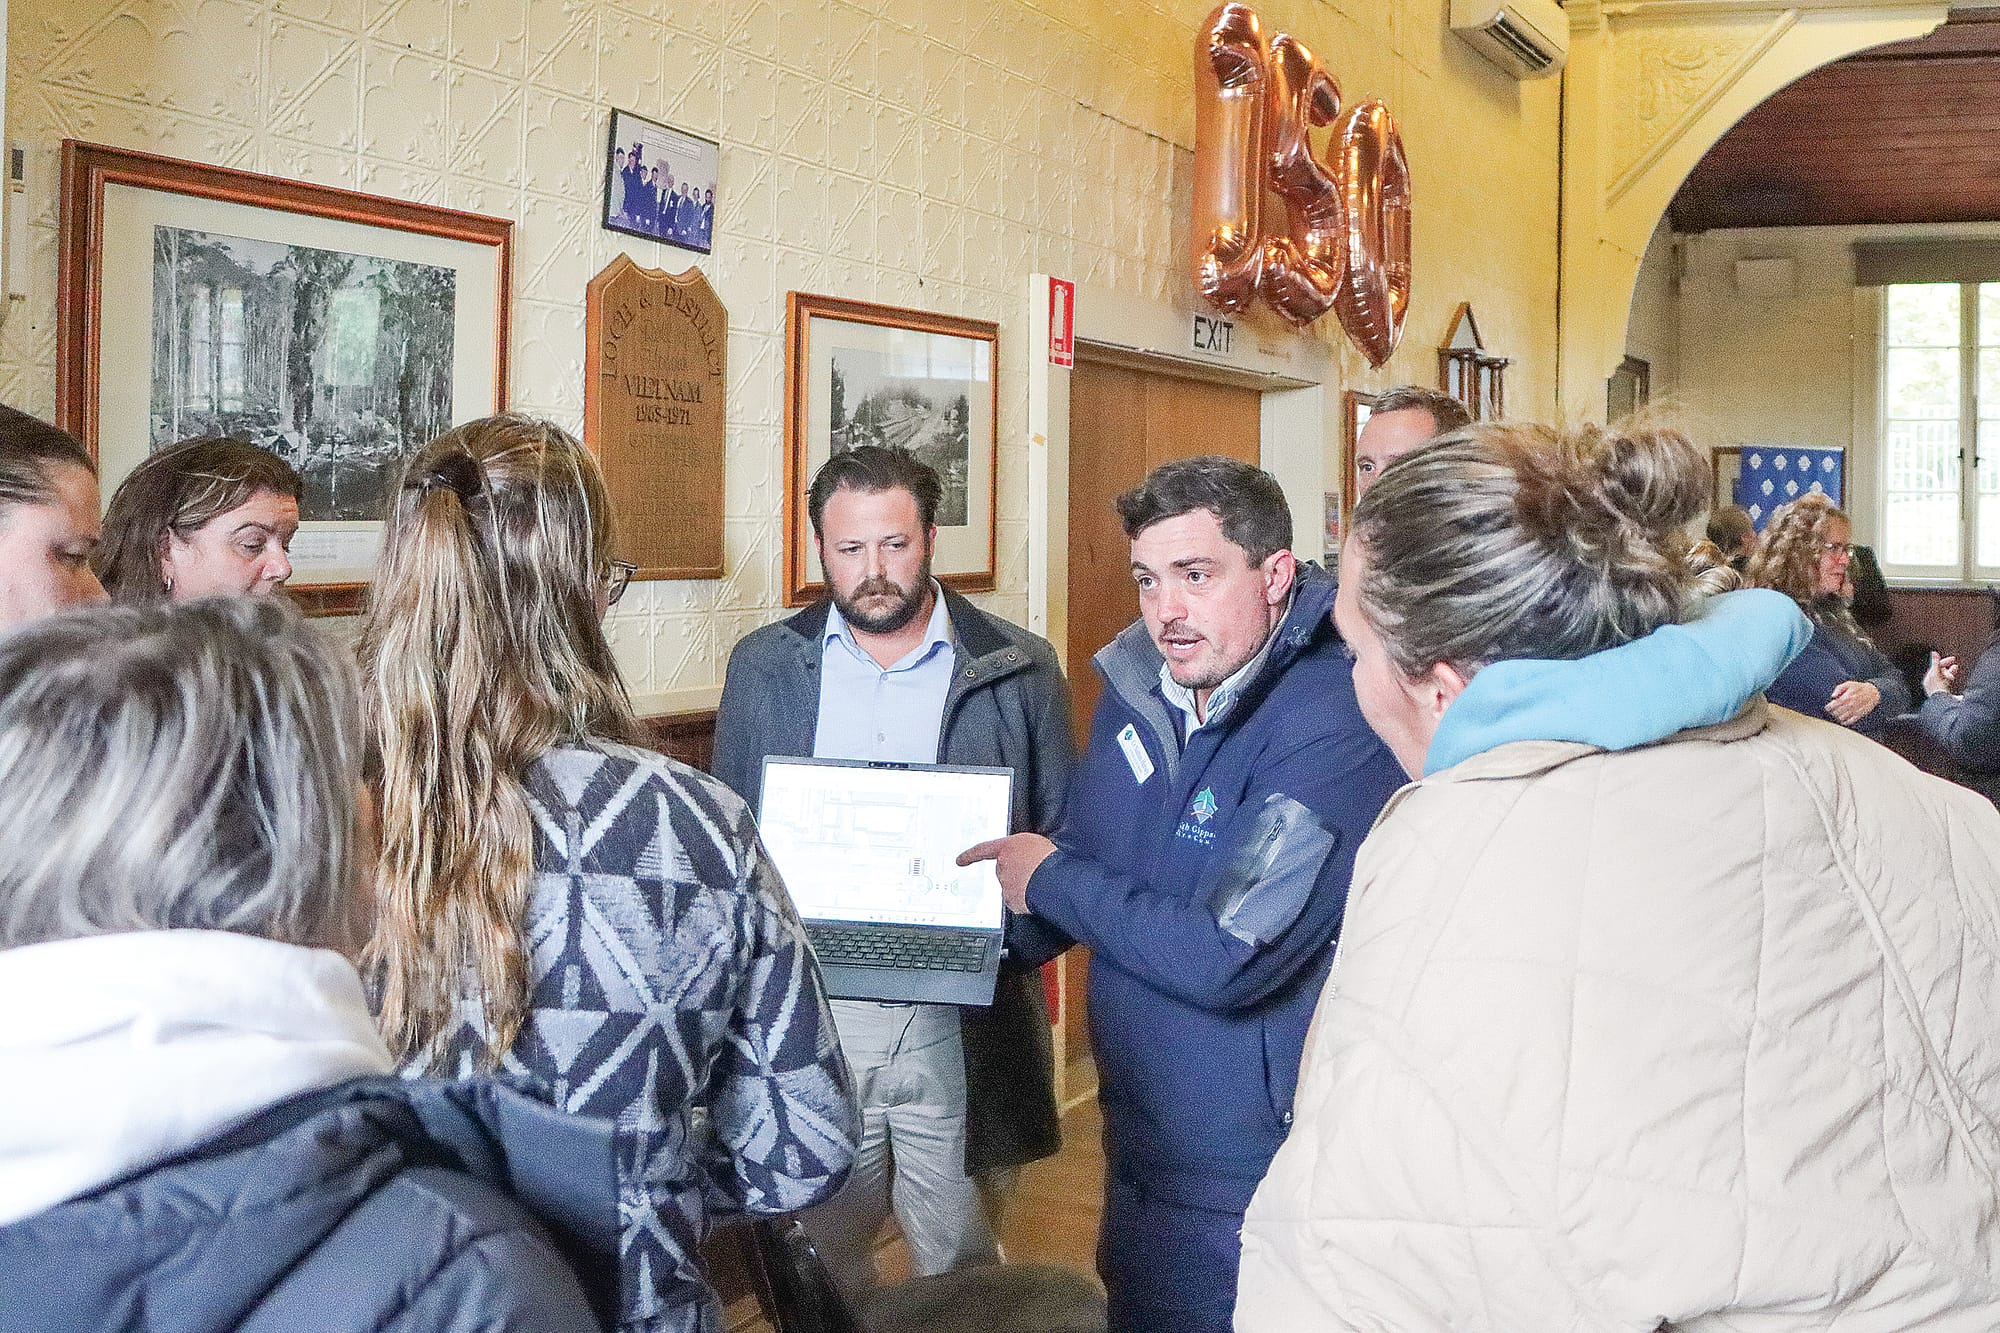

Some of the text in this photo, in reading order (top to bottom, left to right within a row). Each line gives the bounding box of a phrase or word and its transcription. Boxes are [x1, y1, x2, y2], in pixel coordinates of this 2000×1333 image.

[1192, 1, 1412, 368] 150
[601, 302, 634, 380] LOCH
[1194, 315, 1234, 353] EXIT
[624, 375, 703, 404] VIETNAM
